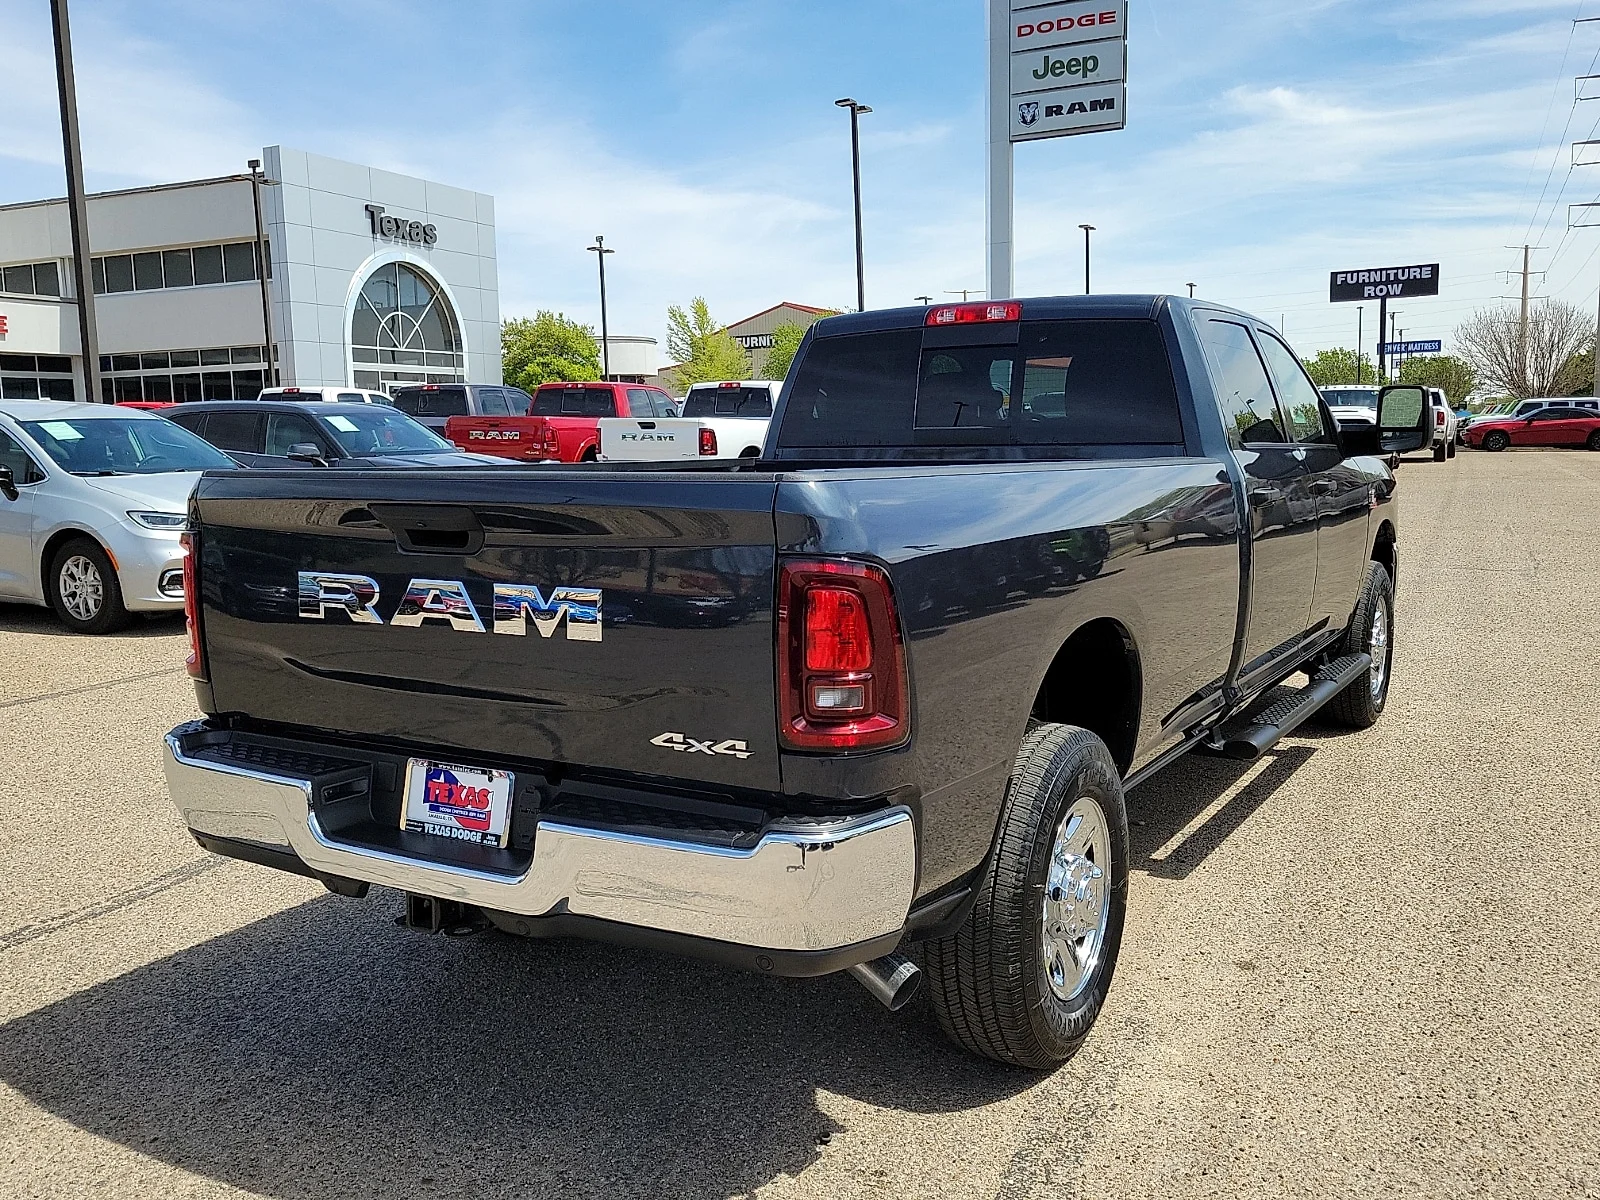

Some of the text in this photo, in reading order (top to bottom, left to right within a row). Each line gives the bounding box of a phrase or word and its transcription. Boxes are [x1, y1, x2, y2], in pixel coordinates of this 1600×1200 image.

[1017, 10, 1117, 38] DODGE
[1032, 54, 1099, 80] Jeep
[1045, 98, 1115, 117] RAM
[364, 203, 438, 245] Texas
[1336, 266, 1432, 285] FURNITURE
[1363, 283, 1403, 298] ROW
[1407, 341, 1439, 352] MATTRESS
[469, 430, 520, 440] RAM
[297, 571, 603, 642] RAM
[427, 780, 491, 811] TEXAS
[424, 822, 451, 838] TEXAS
[450, 828, 482, 843] DODGE
